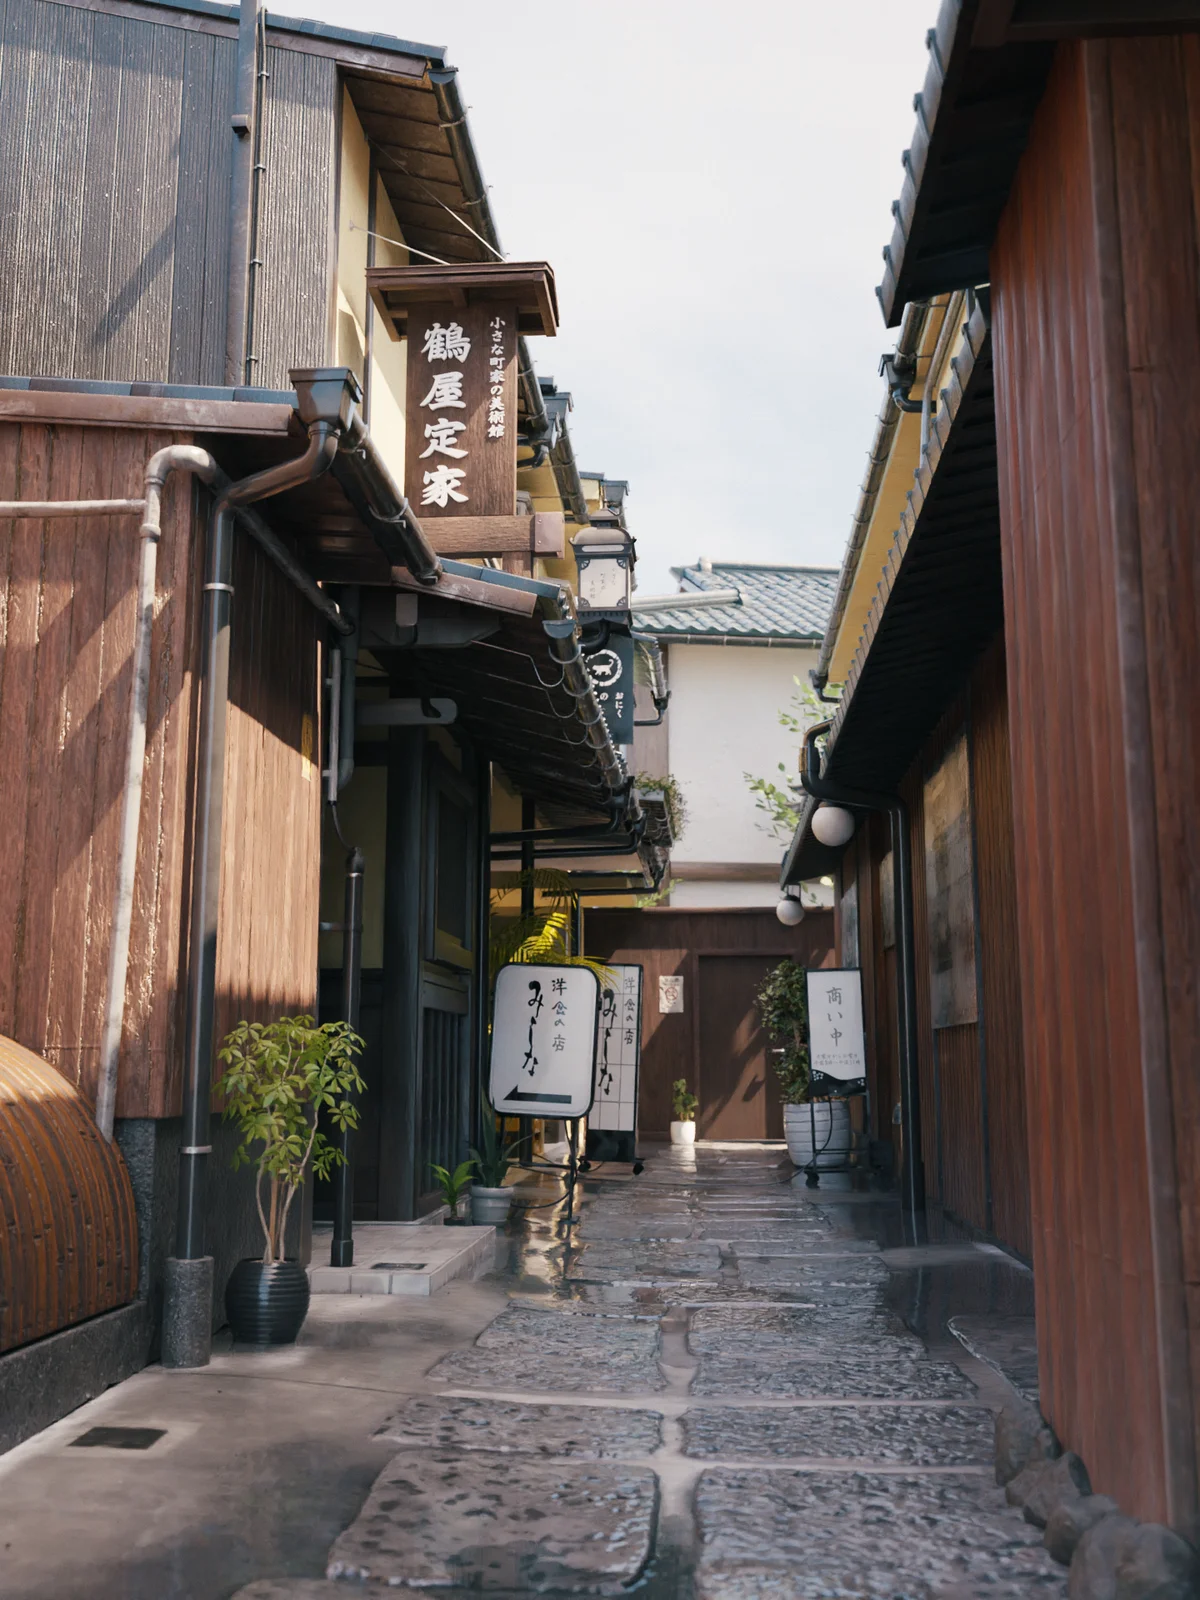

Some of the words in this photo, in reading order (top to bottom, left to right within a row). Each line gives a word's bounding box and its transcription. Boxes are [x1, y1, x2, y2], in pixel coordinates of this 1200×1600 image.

[418, 321, 472, 509] 鶴屋定家
[487, 316, 506, 439] 小さな町家の美術館
[614, 691, 625, 719] おにく
[521, 980, 545, 1077] みしな
[551, 977, 568, 1052] 洋食の店
[624, 976, 636, 1045] 洋食の店
[825, 986, 843, 1047] 商い中
